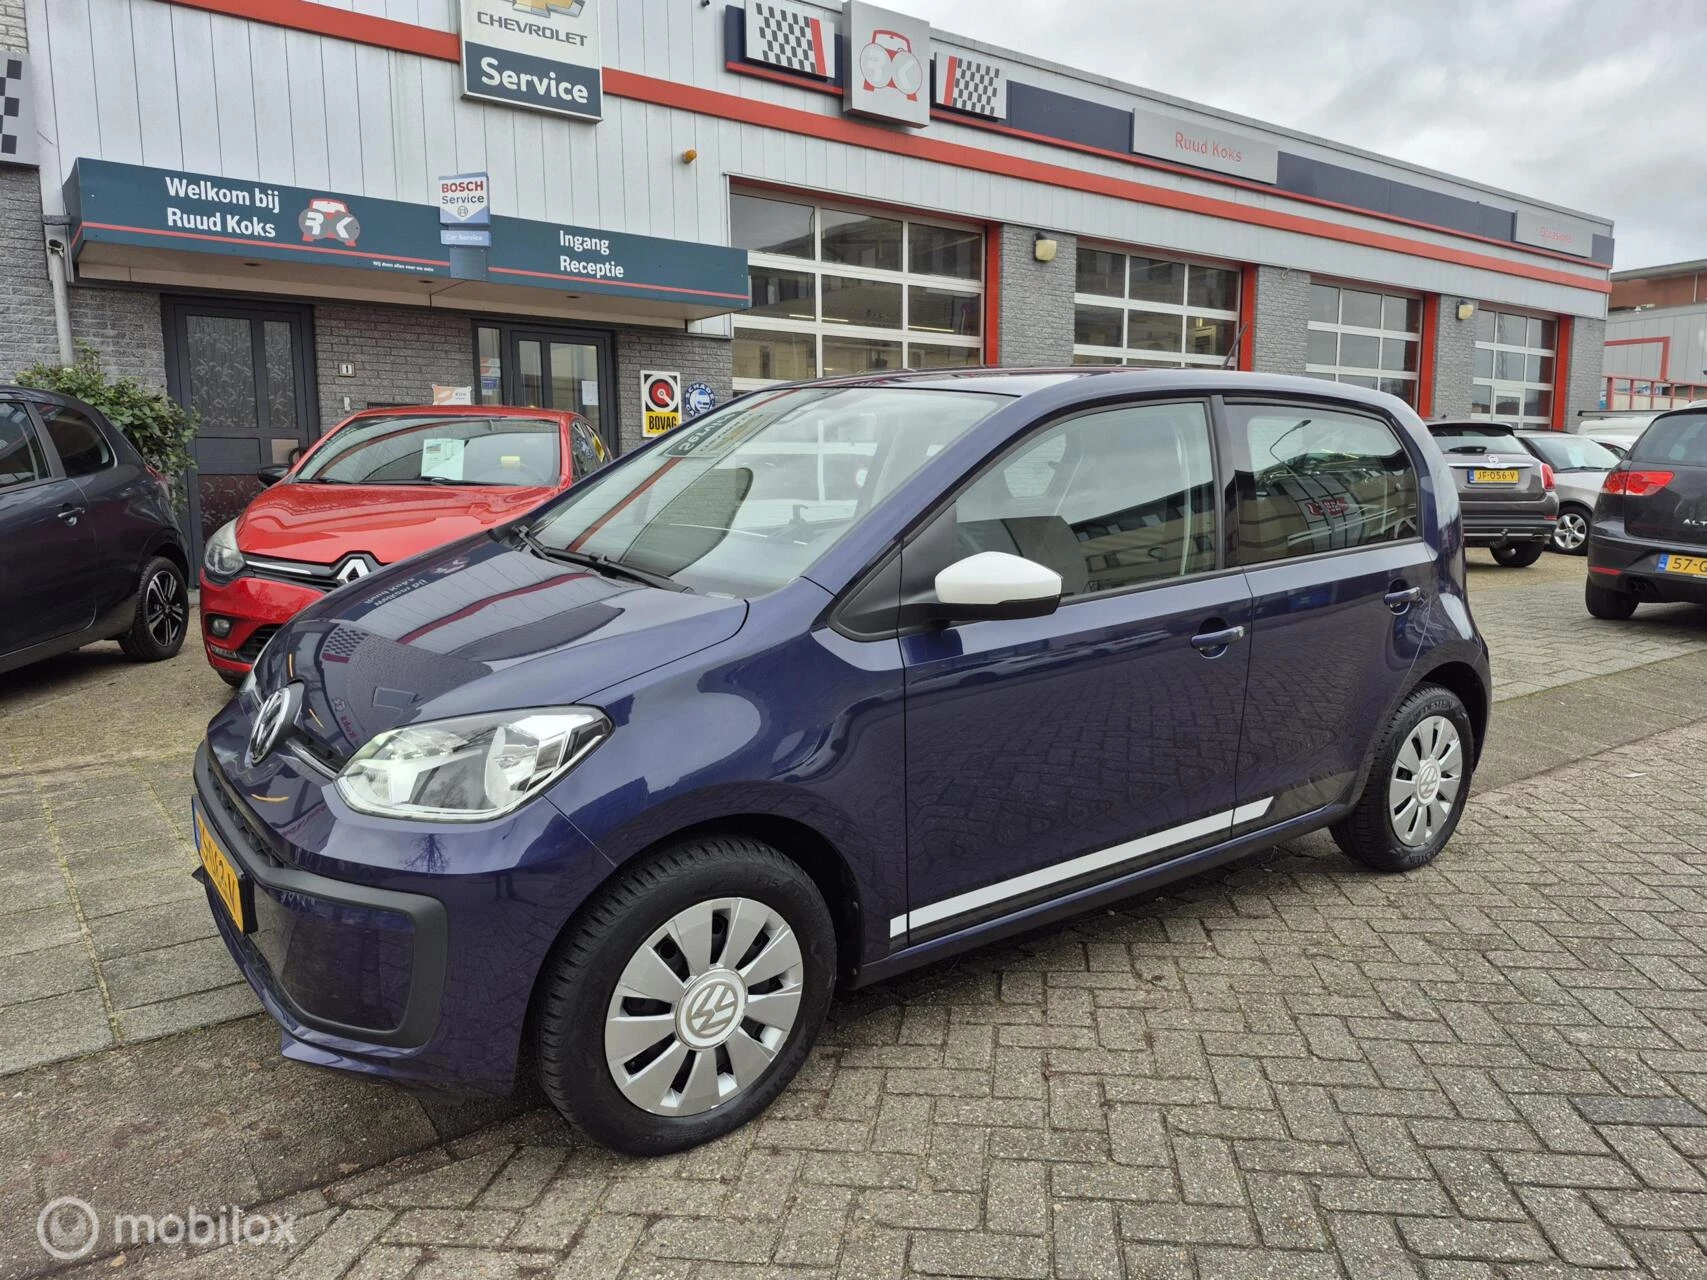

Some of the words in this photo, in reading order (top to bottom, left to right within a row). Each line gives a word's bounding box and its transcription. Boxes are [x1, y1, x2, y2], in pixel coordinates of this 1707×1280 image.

[477, 11, 588, 47] CHEVROLET
[480, 56, 589, 104] Service
[1175, 131, 1208, 154] Ruud
[1212, 141, 1243, 162] Koks
[165, 176, 250, 206] Welkom
[254, 187, 280, 214] bij
[441, 180, 484, 193] BOSCH
[441, 193, 485, 205] Service
[166, 207, 222, 232] Ruud
[226, 214, 276, 238] Koks
[559, 230, 610, 256] Ingang
[559, 255, 625, 279] Receptie
[648, 415, 677, 430] BOVAG
